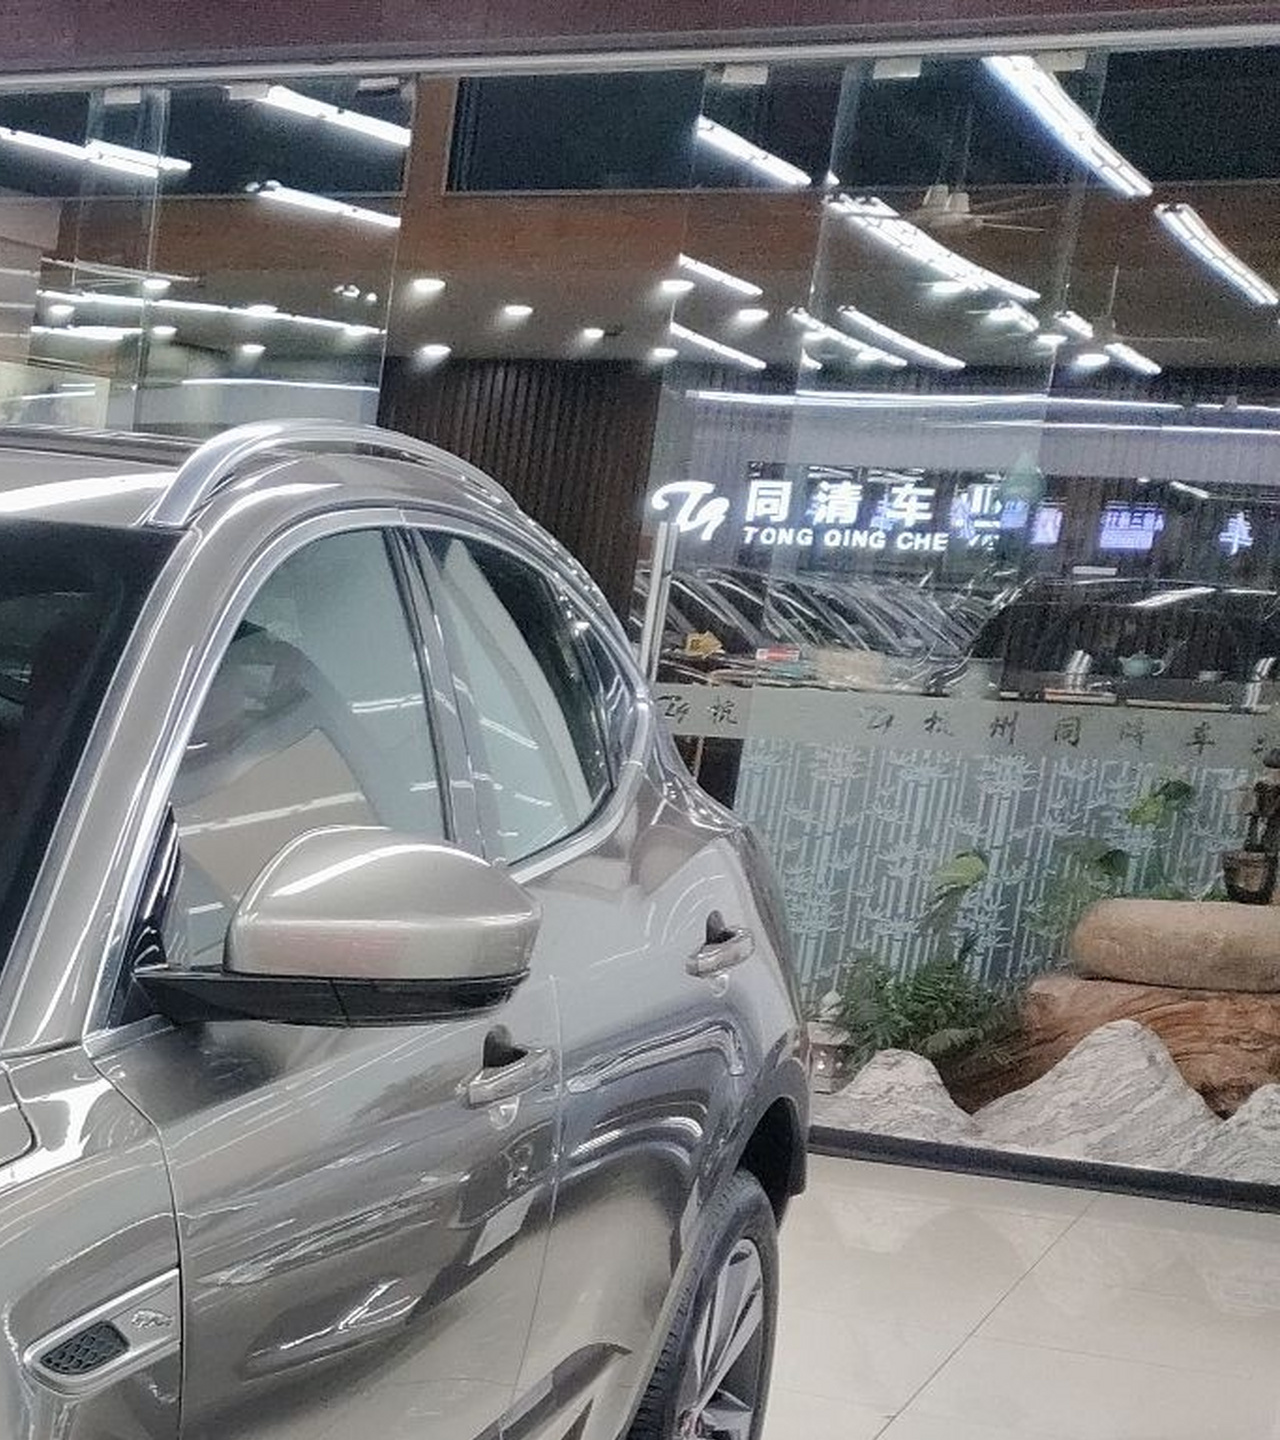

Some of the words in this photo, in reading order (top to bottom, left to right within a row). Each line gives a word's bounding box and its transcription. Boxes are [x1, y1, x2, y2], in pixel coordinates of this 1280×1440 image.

[743, 527, 814, 546] TONG
[824, 529, 886, 548] QING
[896, 532, 949, 551] CHE
